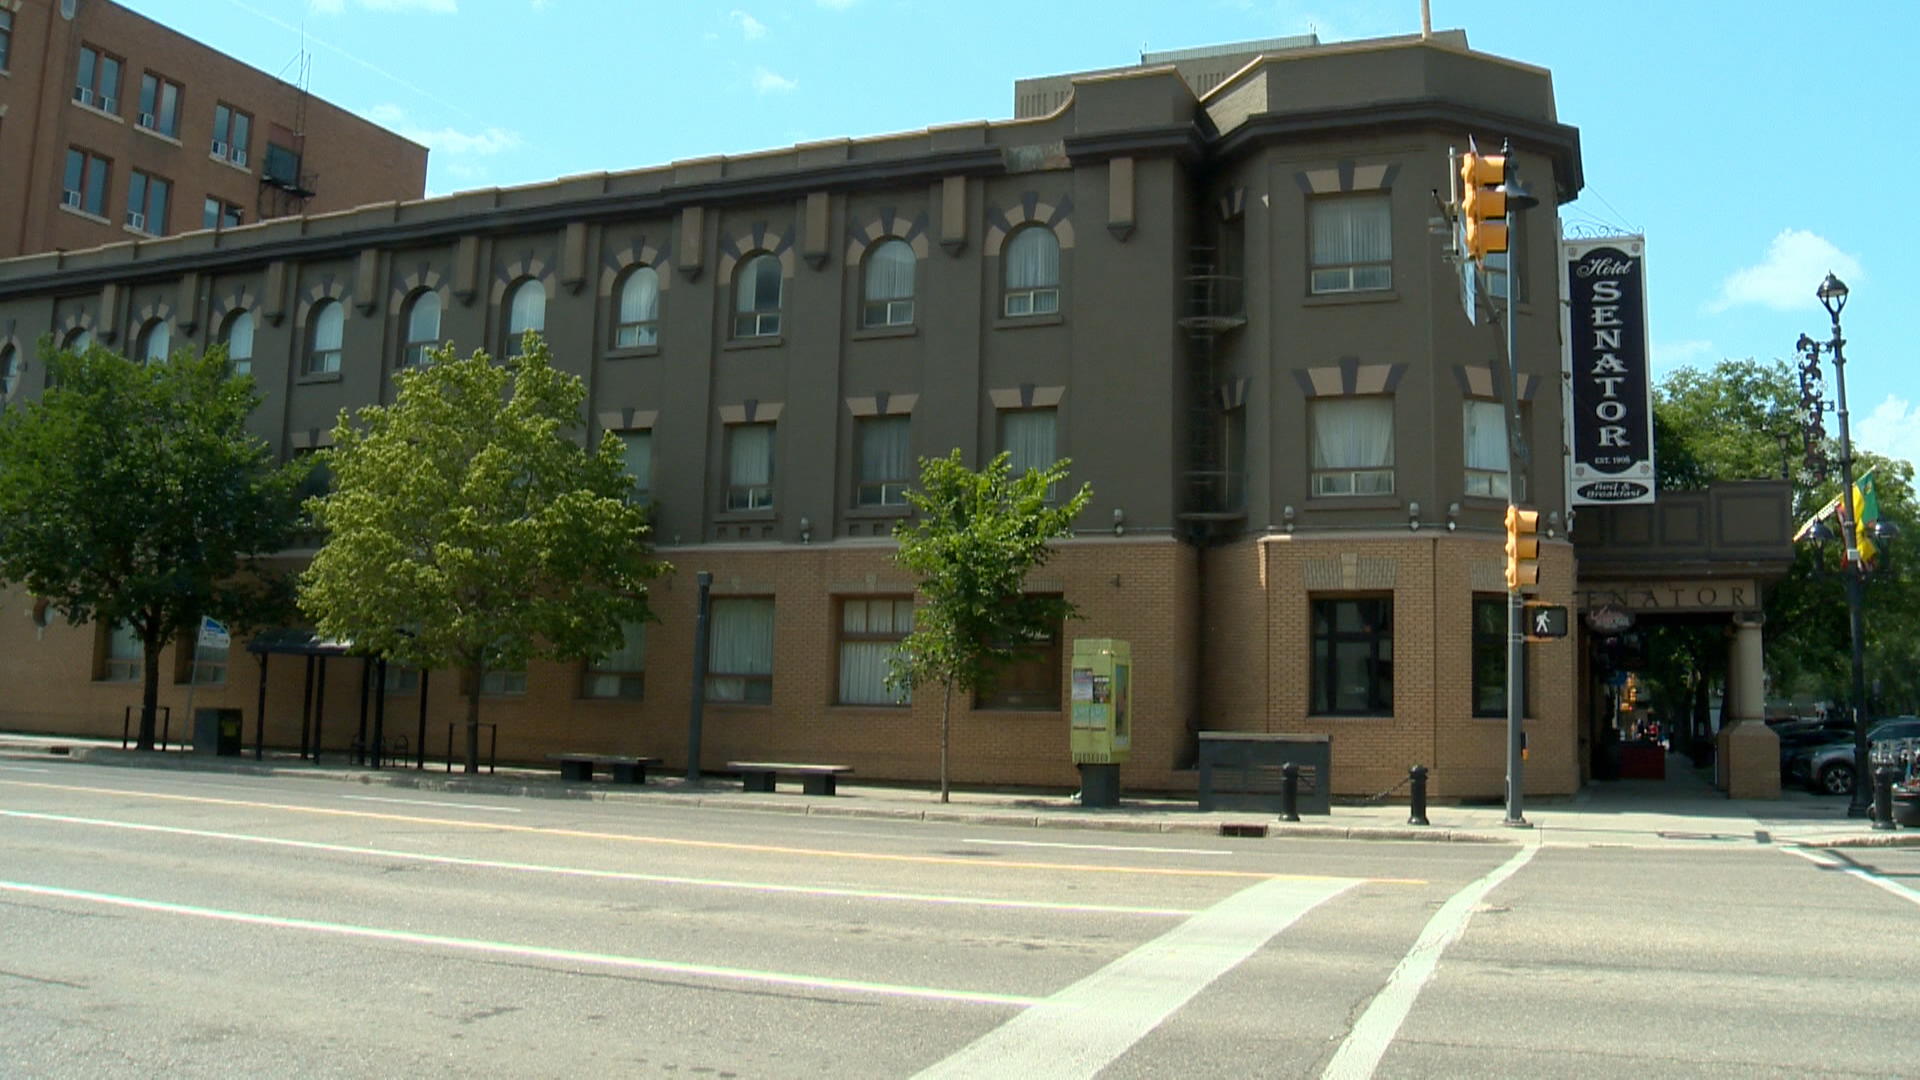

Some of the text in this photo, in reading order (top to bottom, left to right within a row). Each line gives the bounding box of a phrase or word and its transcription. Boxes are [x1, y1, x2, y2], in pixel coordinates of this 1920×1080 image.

[1576, 257, 1634, 278] Hotel
[1590, 280, 1631, 448] SENATOR
[1586, 487, 1641, 497] Breakfast
[1586, 586, 1746, 608] ENATOR
